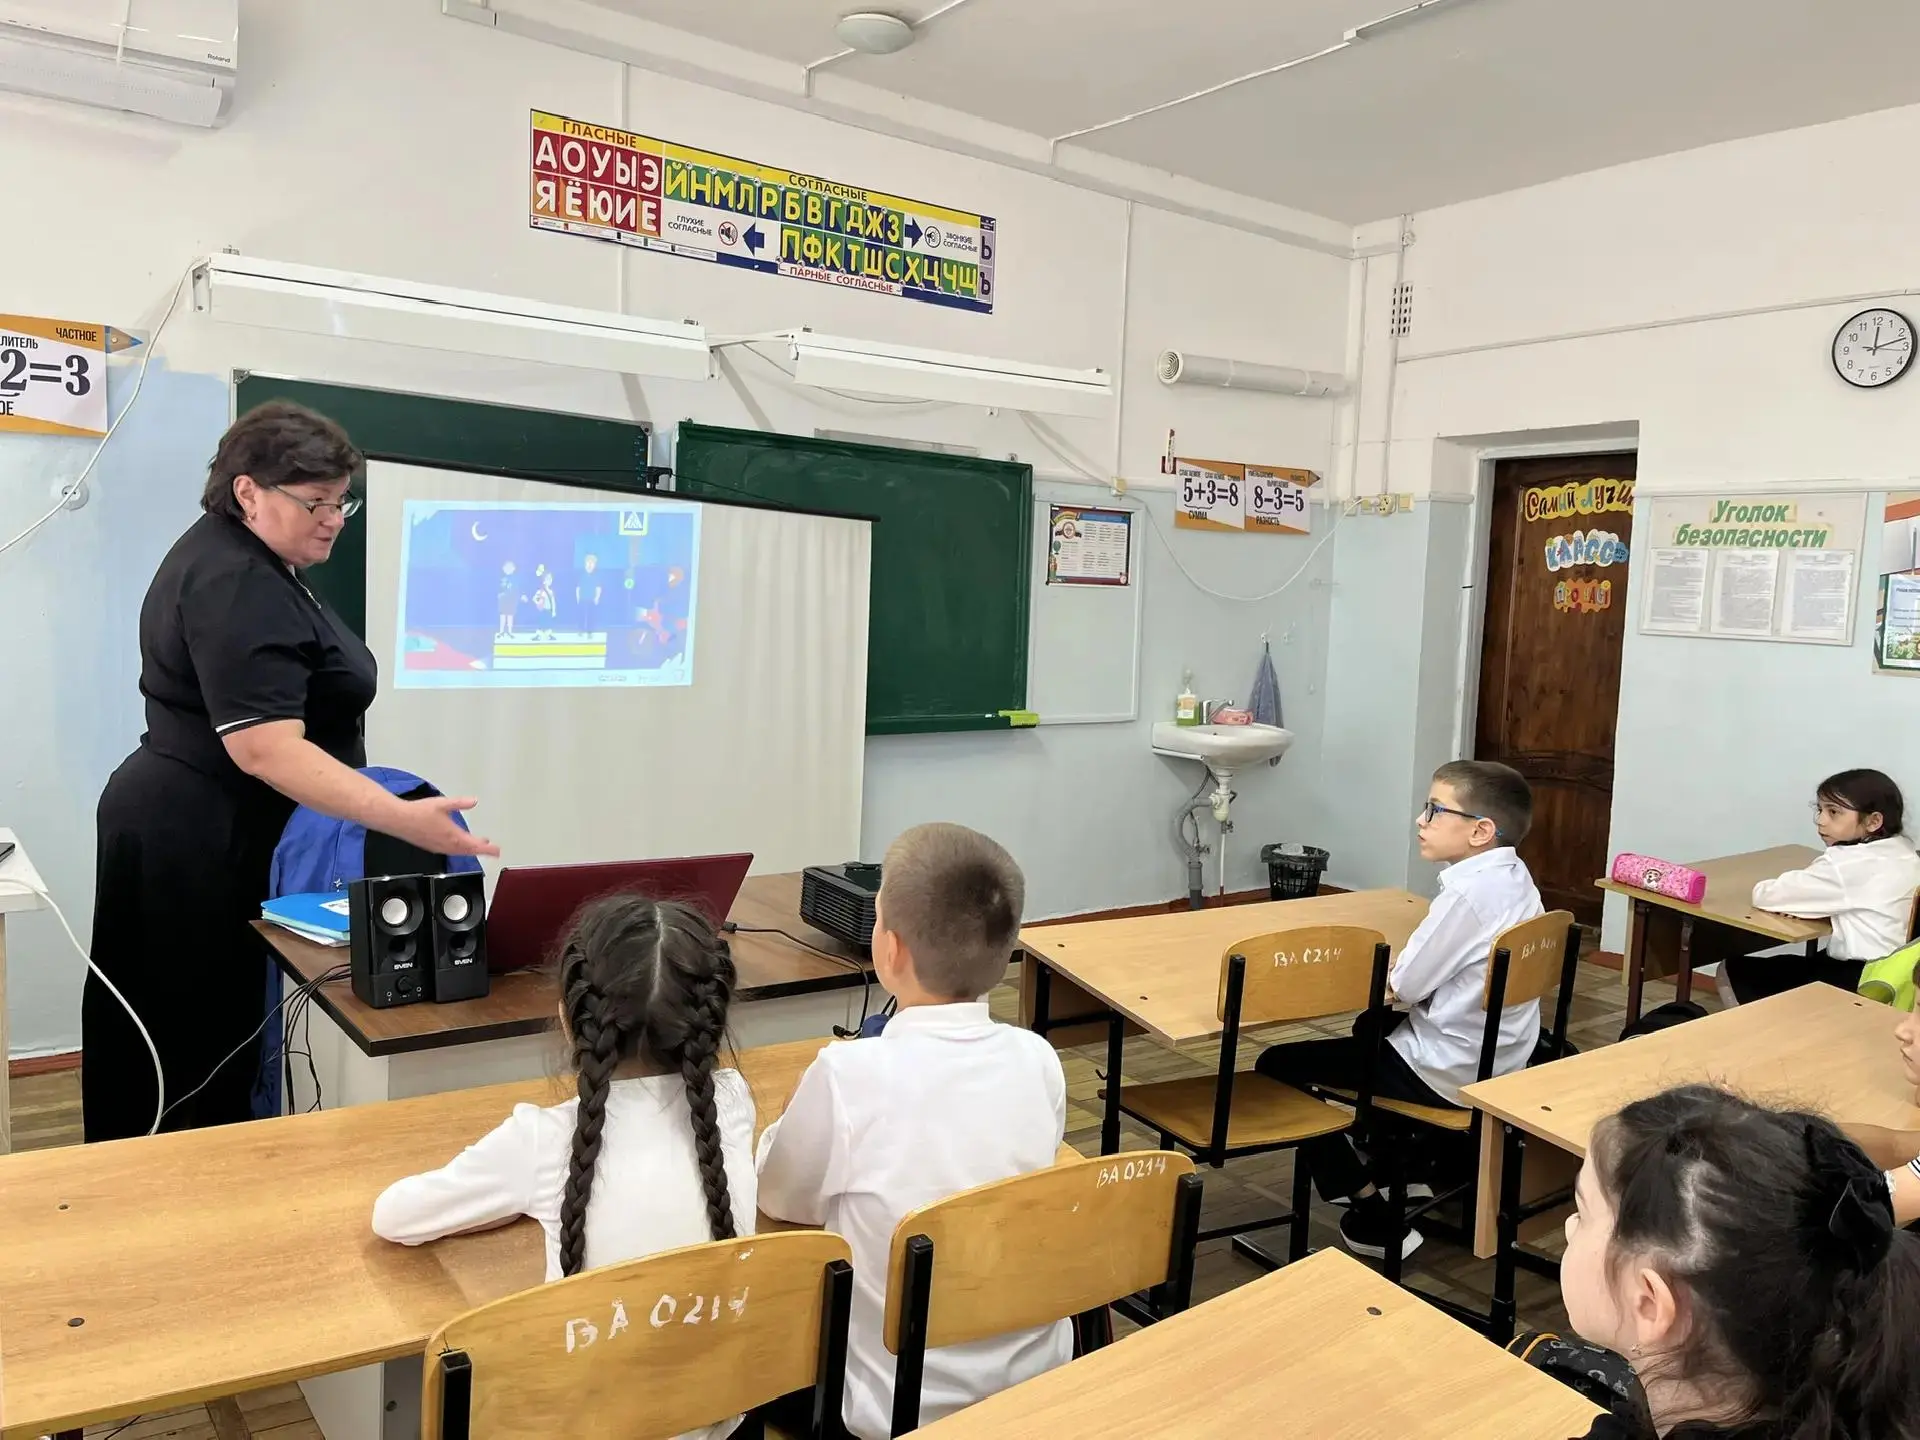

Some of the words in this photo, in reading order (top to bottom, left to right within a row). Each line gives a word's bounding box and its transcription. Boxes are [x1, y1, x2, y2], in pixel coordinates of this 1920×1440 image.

[207, 53, 231, 63] Roland
[562, 121, 637, 148] ГЛАСНЫЕ
[789, 174, 868, 202] СОГЛАСНЫЕ
[676, 215, 705, 227] ГЛУХИЕ
[668, 221, 713, 237] СОГЛАСНЫЕ
[790, 267, 832, 282] ПАРНЫЕ
[836, 275, 894, 293] СОГЛАСНЫЕ
[1872, 316, 1884, 326] 12
[1889, 319, 1894, 329] 1
[1858, 322, 1868, 331] 11
[55, 327, 97, 342] ЧАСТНОЕ
[1848, 333, 1859, 342] 10
[1898, 328, 1906, 337] 2
[1843, 346, 1850, 356] 9
[1902, 341, 1910, 351] 3
[1847, 359, 1854, 369] 8
[1897, 356, 1903, 365] 4
[1857, 369, 1865, 378] 7
[1870, 371, 1878, 381] 6
[1885, 367, 1892, 377] 5
[1183, 477, 1239, 507] 5+3=8
[1711, 500, 1790, 523] Уголок
[1675, 523, 1828, 548] безопасности
[394, 962, 413, 970] SVEN
[454, 957, 473, 966] SVEN
[1124, 1156, 1166, 1181] 0214
